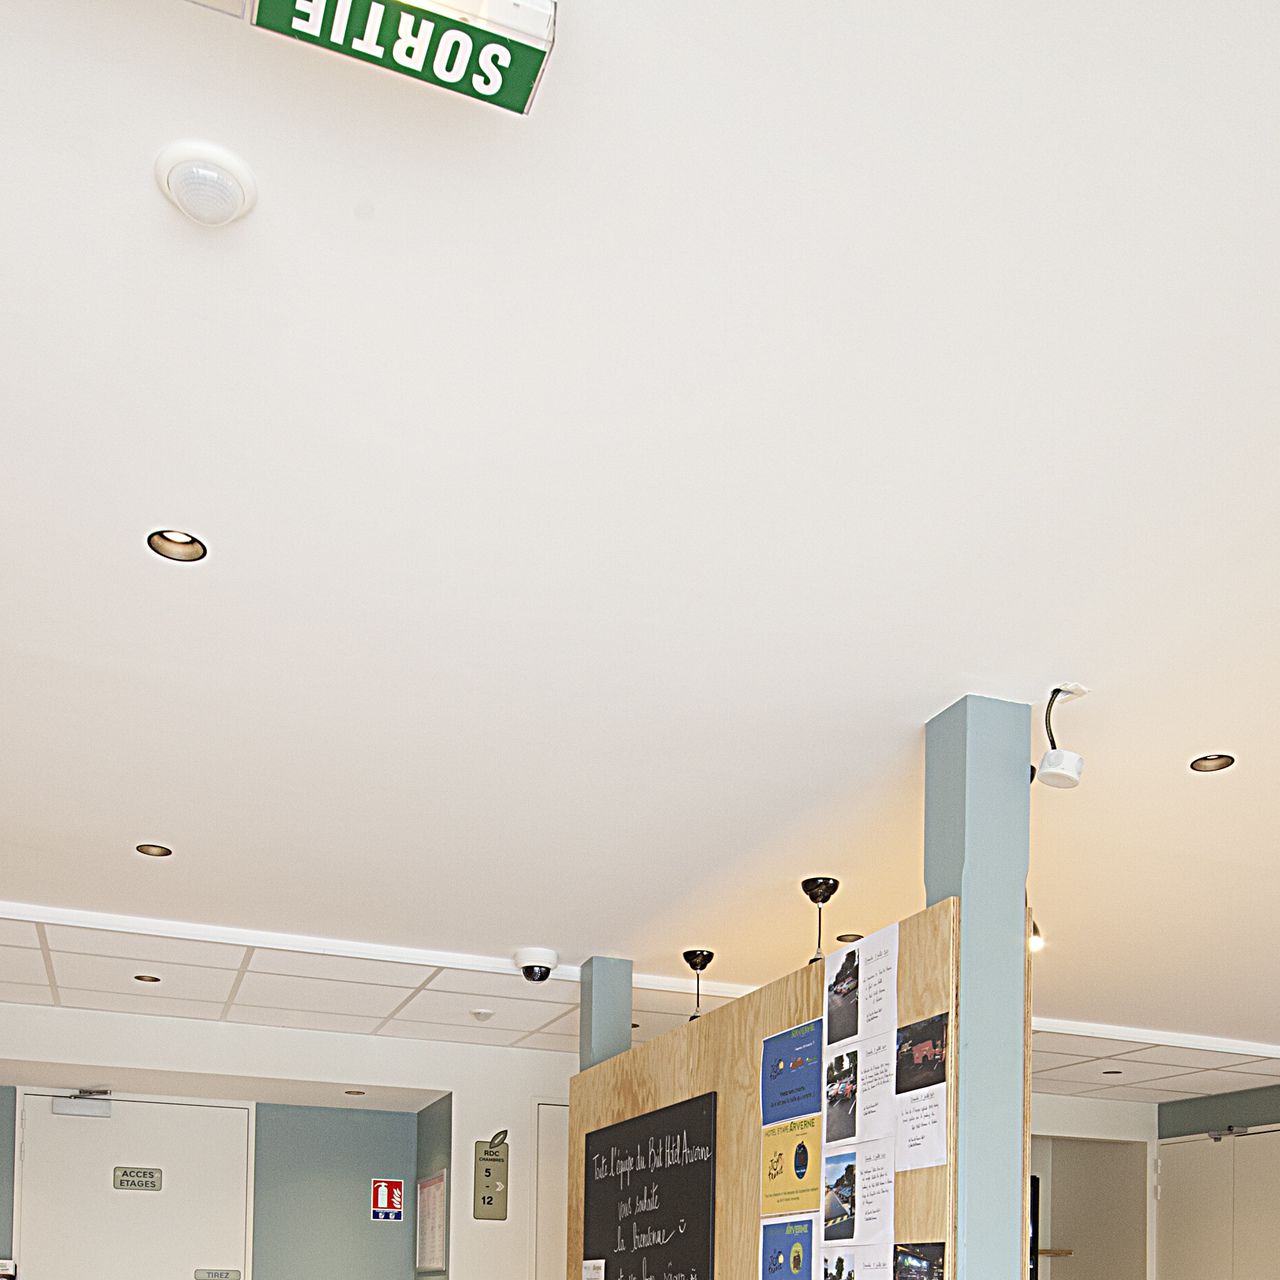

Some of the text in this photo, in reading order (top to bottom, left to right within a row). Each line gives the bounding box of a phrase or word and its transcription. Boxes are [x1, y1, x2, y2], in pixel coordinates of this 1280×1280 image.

[635, 1144, 646, 1171] du
[121, 1170, 155, 1179] ACCES
[484, 1168, 491, 1178] 5
[119, 1179, 156, 1188] ETAGES
[481, 1195, 494, 1206] 12
[617, 1196, 632, 1221] vous
[614, 1226, 626, 1253] la
[206, 1271, 230, 1279] TIREZ
